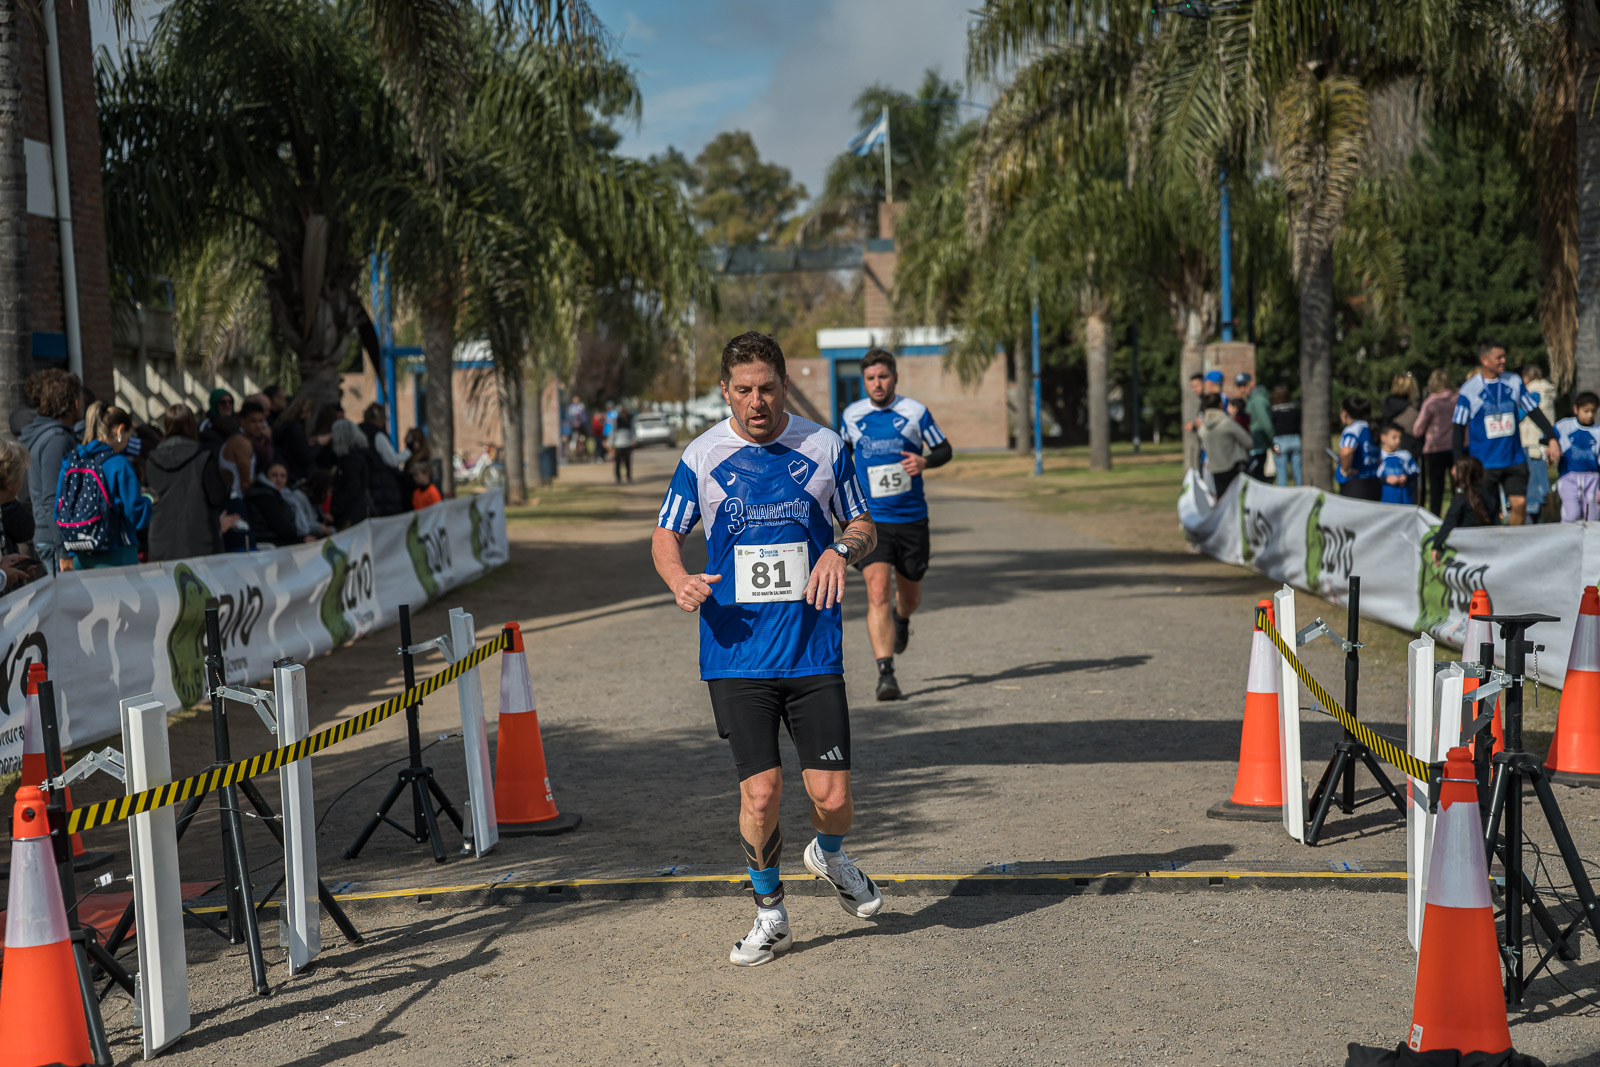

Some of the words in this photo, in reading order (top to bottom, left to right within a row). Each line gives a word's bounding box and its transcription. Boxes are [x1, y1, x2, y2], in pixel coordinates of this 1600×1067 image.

[879, 472, 902, 488] 45
[725, 497, 745, 535] 3
[746, 498, 810, 519] MARATÓN
[752, 561, 791, 588] 81
